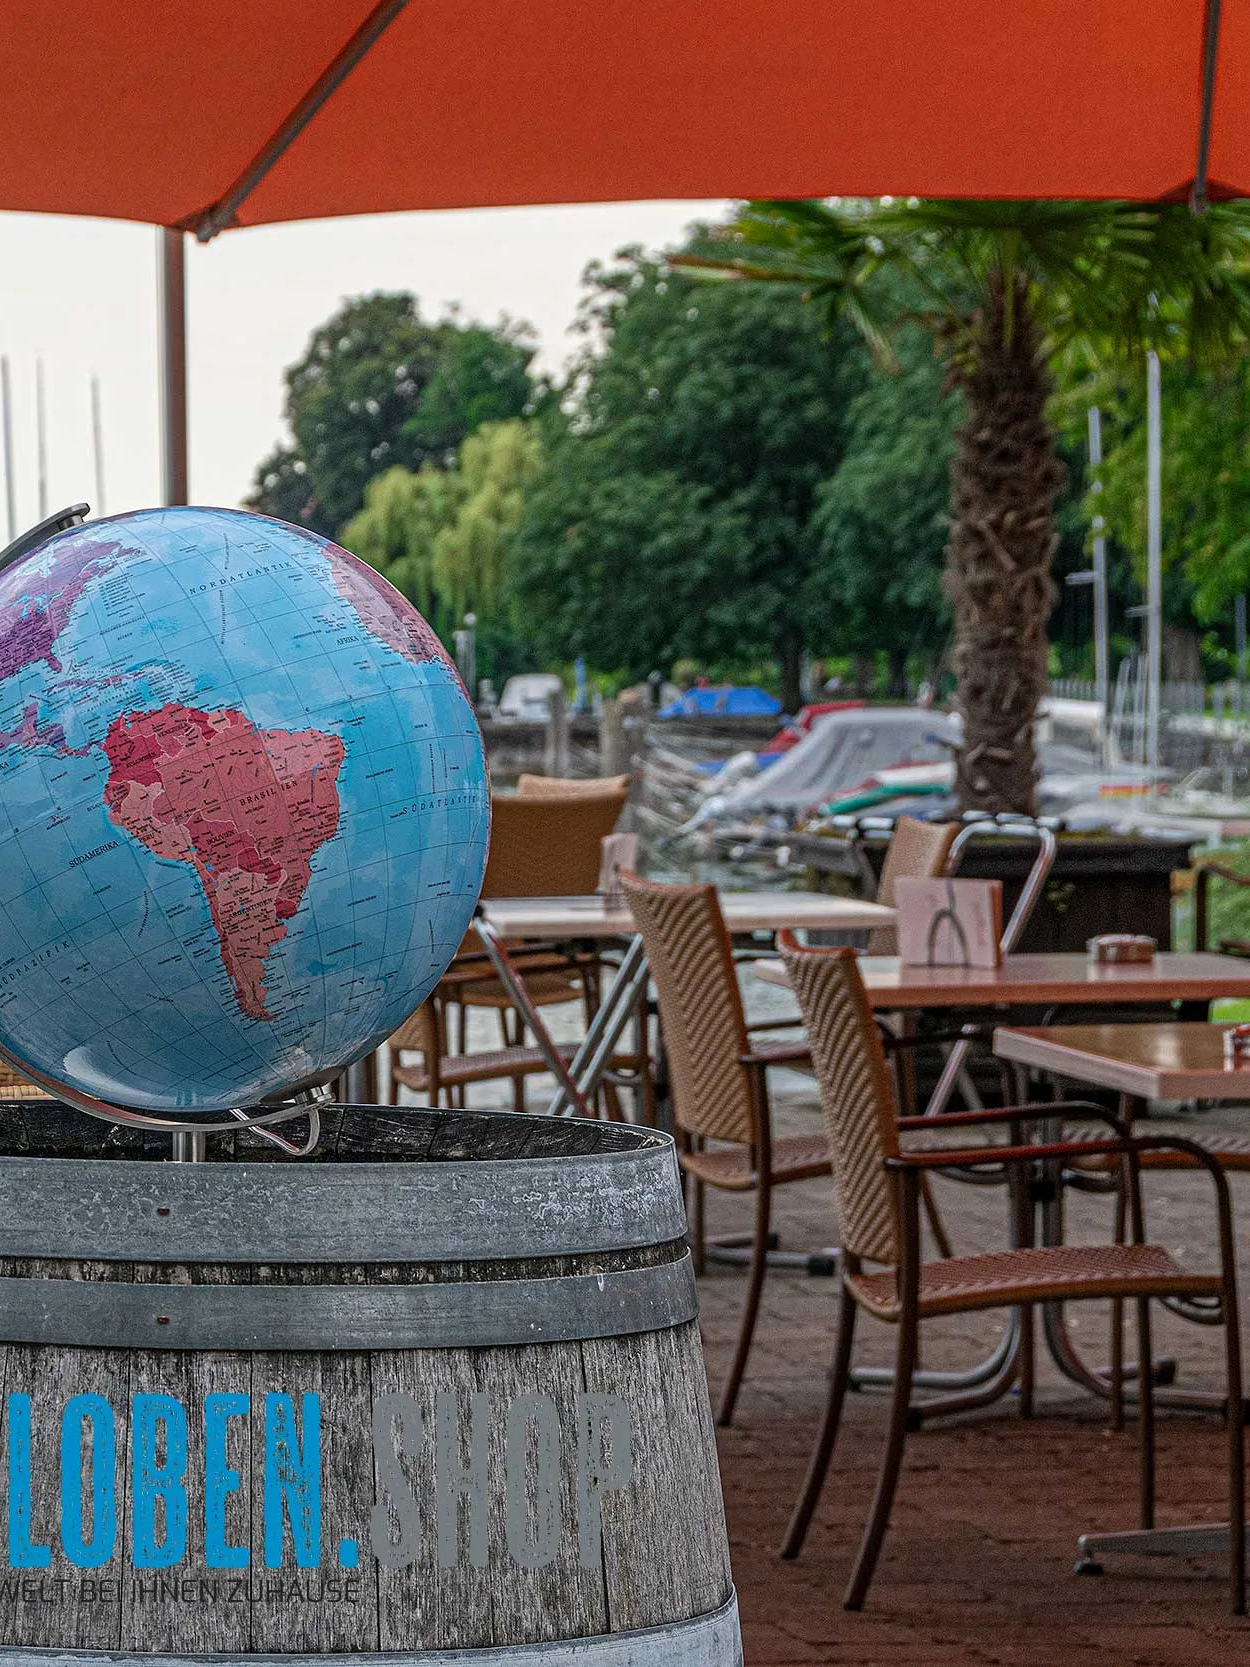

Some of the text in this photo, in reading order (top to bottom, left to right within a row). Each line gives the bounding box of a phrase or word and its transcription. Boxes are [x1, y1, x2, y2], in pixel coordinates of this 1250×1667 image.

[189, 562, 292, 595] NORDATLANTIK
[336, 635, 360, 646] AFRIKA
[69, 840, 119, 868] SÜDAMERIKA
